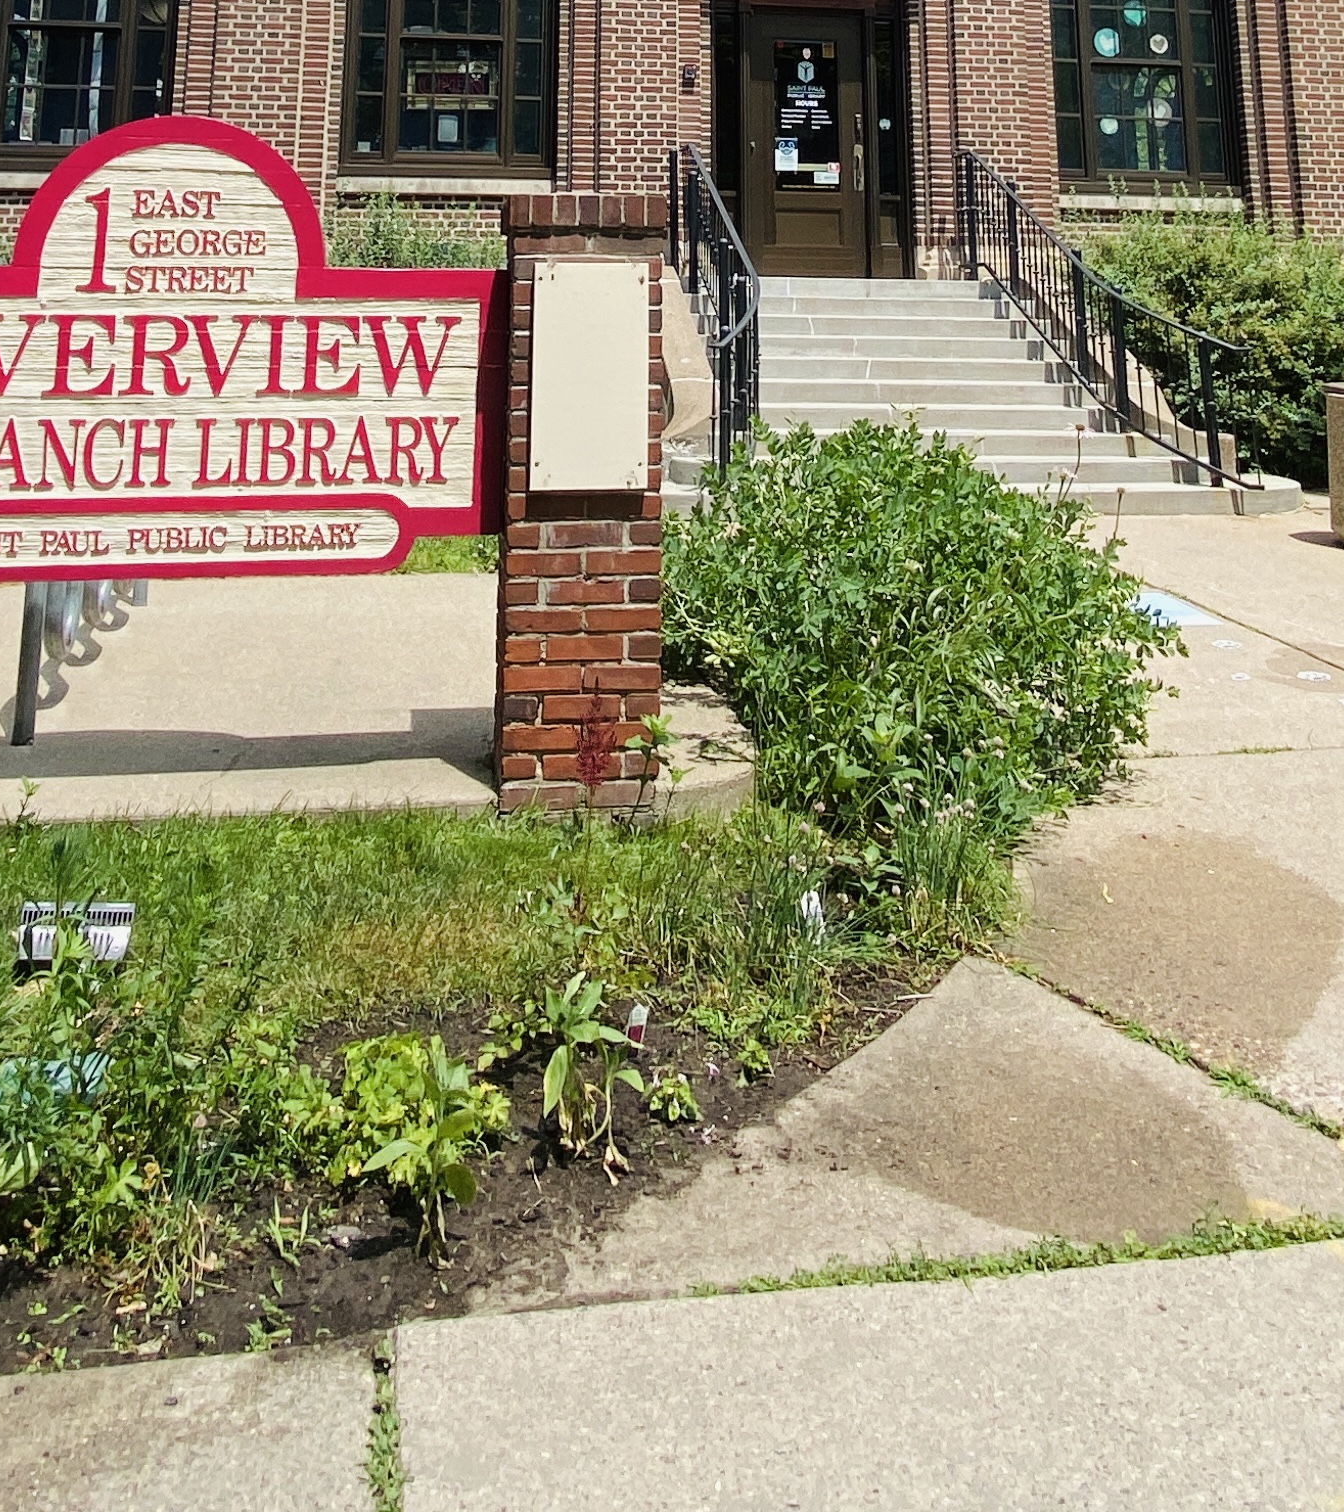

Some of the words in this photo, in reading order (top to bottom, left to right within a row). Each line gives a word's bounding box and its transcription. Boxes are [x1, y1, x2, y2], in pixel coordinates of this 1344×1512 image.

[131, 189, 222, 220] EAST
[75, 187, 117, 294] 1
[128, 229, 267, 258] GEORGE
[124, 265, 255, 295] STREET
[191, 415, 460, 490] LIBRARY
[38, 529, 110, 558] PAUL
[125, 526, 229, 555] PUBLIC
[242, 523, 362, 552] LIBRARY
